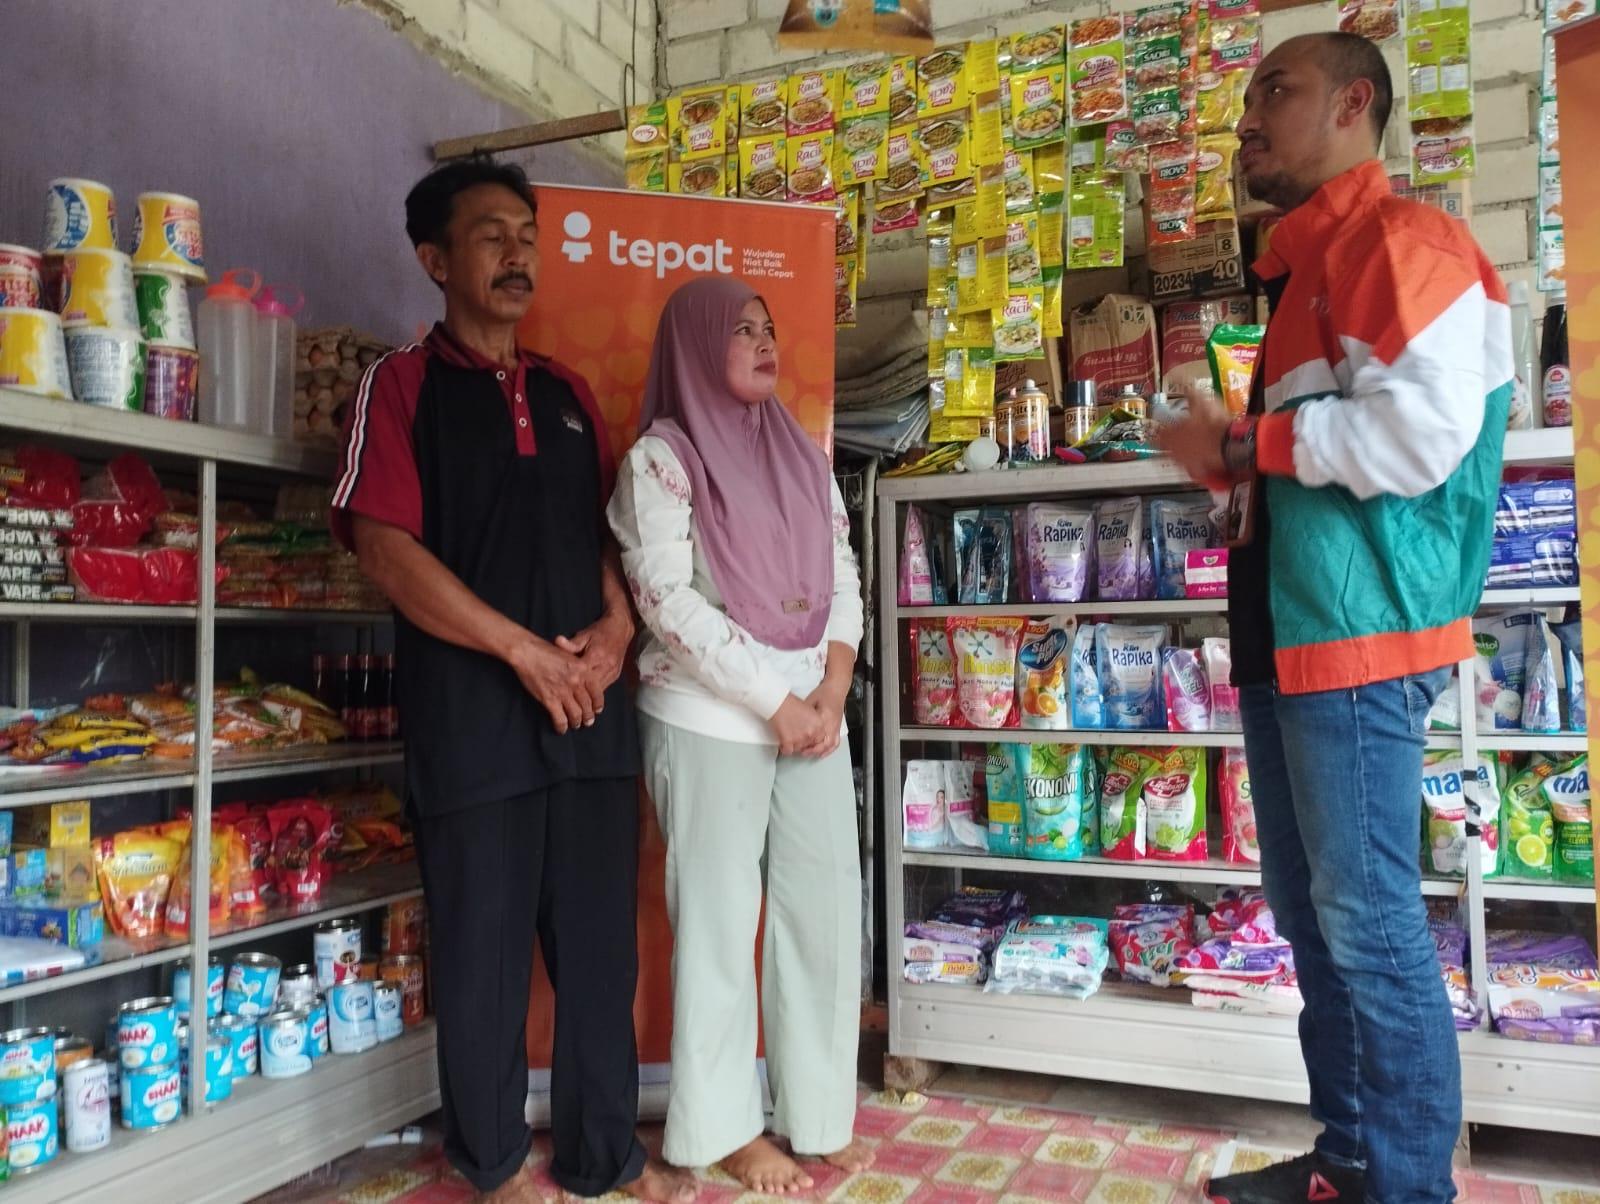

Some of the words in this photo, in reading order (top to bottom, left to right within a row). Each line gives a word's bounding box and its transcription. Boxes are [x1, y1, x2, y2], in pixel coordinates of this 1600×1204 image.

[1023, 83, 1054, 104] Racik
[743, 248, 785, 259] Wujudkan
[1221, 239, 1232, 251] 8
[609, 230, 734, 279] tepat
[743, 258, 762, 267] Niat
[763, 259, 782, 268] Baik
[743, 267, 767, 276] Lebih
[768, 268, 795, 279] Cepat
[1213, 258, 1239, 279] 40
[1001, 301, 1033, 317] Racik
[7, 508, 49, 526] VAPE
[1044, 525, 1084, 543] Rapika
[1166, 522, 1208, 540] Rapika
[4, 548, 42, 564] VAPE
[3, 584, 41, 600] VAPE
[1112, 648, 1153, 667] Rapika
